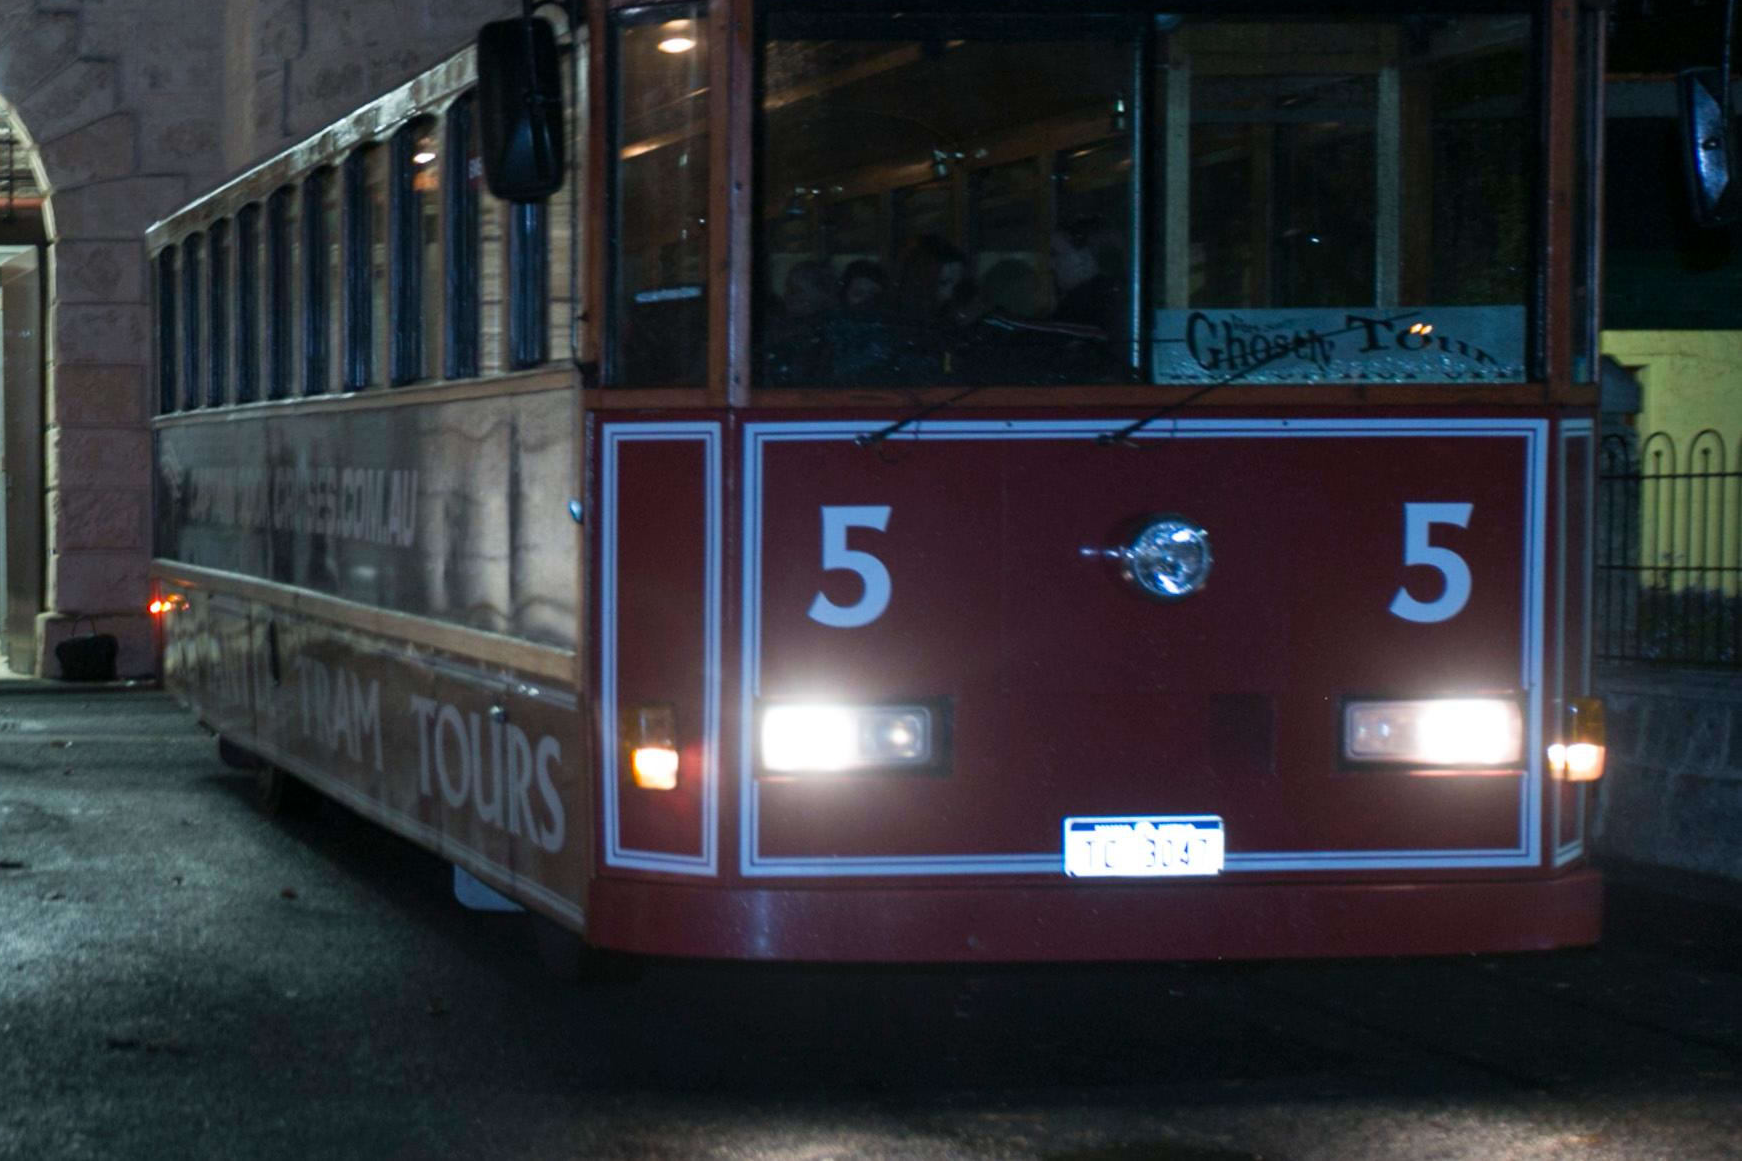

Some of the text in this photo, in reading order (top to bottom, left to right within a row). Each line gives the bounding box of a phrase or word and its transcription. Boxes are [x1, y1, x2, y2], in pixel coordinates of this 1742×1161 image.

[806, 505, 893, 628] 5
[1388, 501, 1475, 625] 5
[293, 653, 384, 773] TRAM
[410, 694, 566, 854] TOURS
